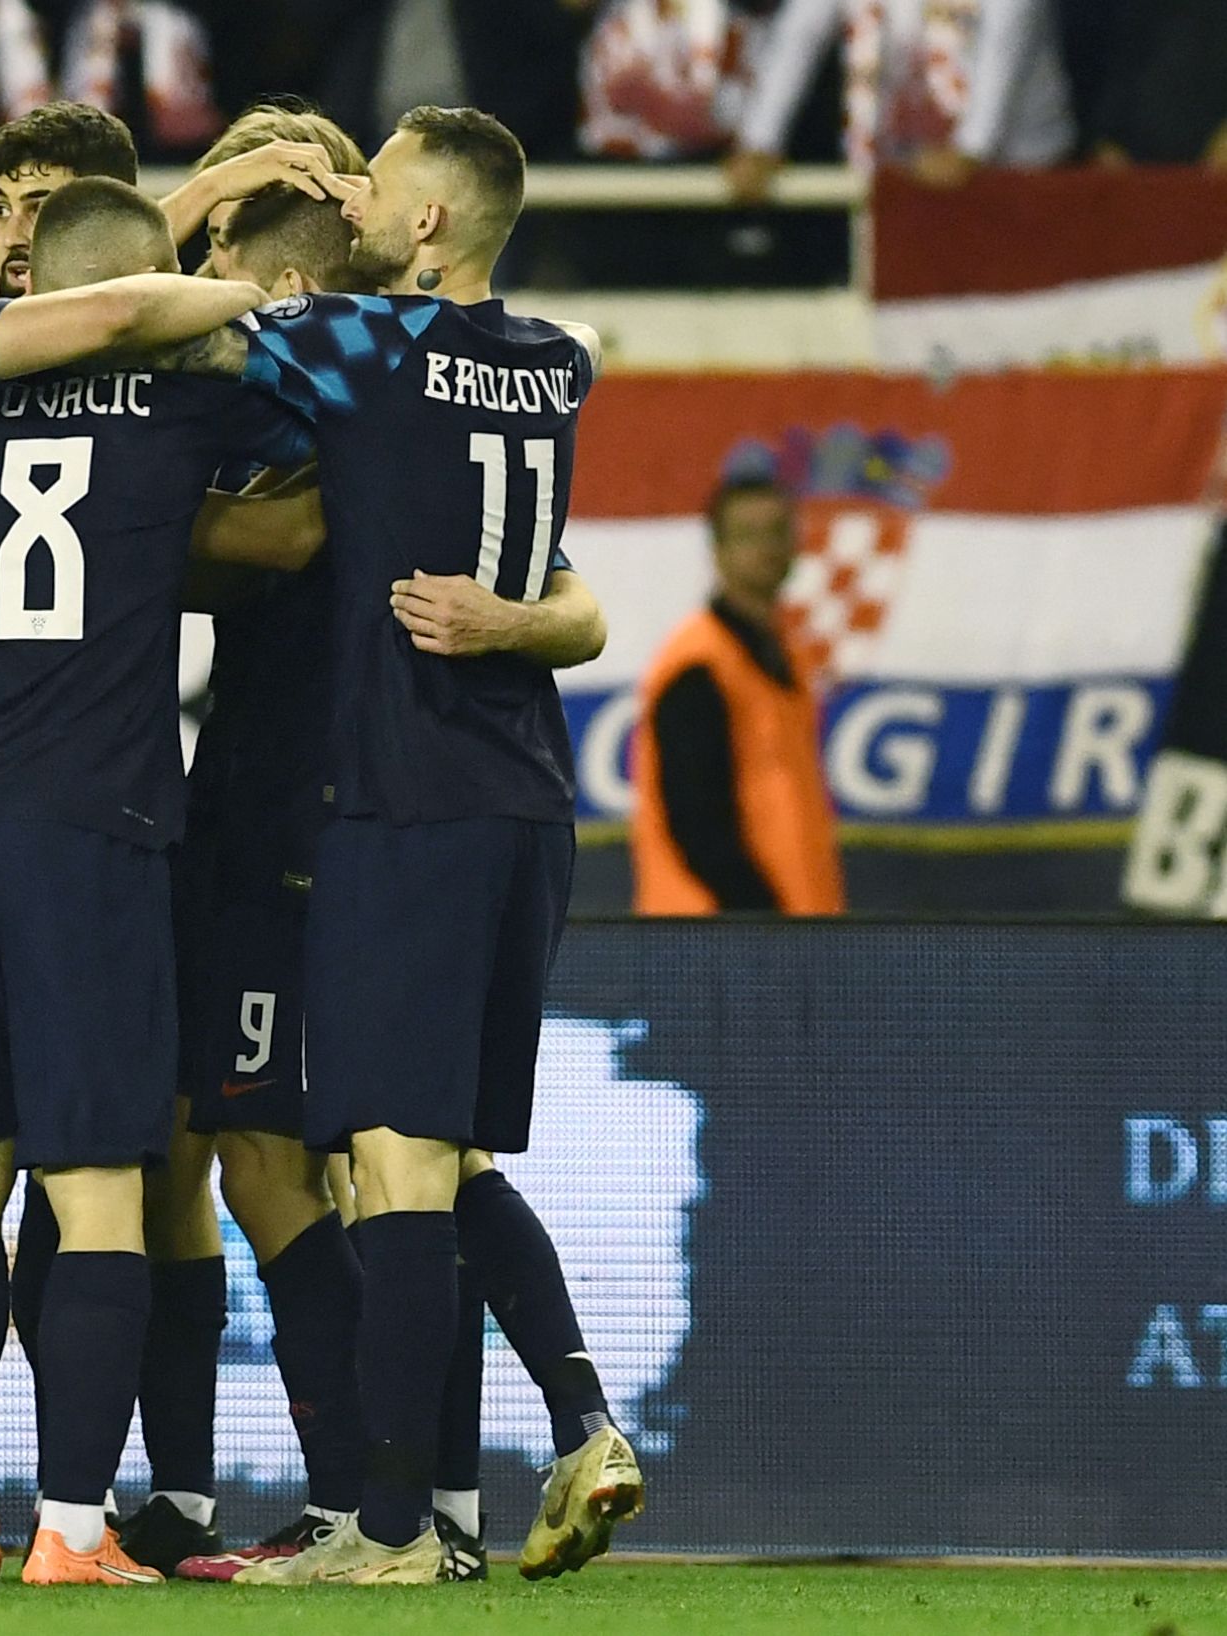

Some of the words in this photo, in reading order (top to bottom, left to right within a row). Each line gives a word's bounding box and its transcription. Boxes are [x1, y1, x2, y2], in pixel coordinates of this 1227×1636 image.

[424, 352, 579, 414] BROZOVIĆ
[469, 432, 555, 601] 11
[235, 991, 276, 1073] 9
